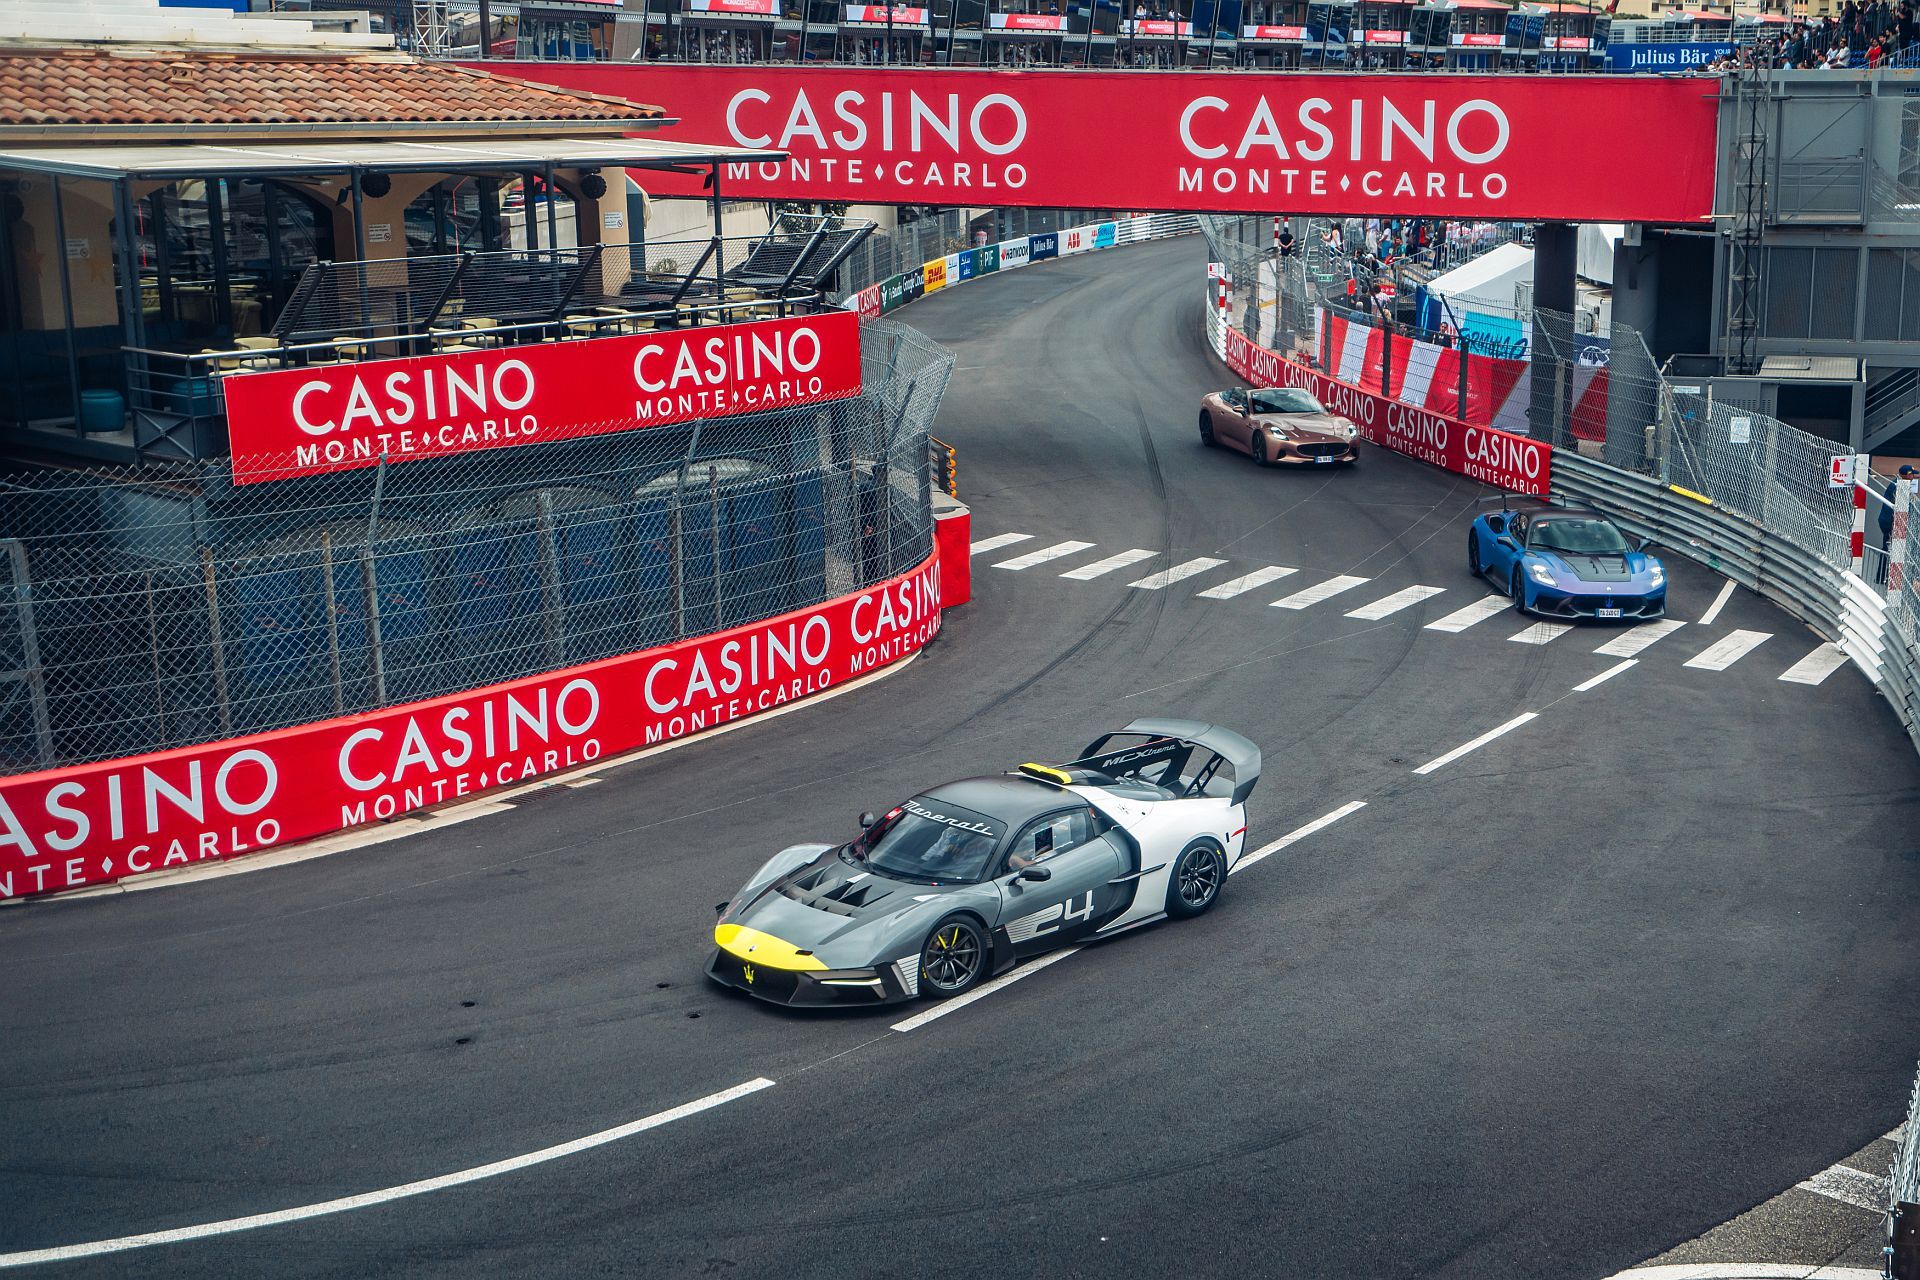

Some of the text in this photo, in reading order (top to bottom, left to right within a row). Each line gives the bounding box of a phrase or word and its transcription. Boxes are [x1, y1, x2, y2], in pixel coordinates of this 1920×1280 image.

[1631, 48, 1710, 68] Julius Bär
[725, 87, 1027, 155] CASINO
[1179, 94, 1510, 164] CASINO
[728, 158, 1027, 188] MONTE CARLO
[1179, 167, 1507, 199] MONTE CARLO
[985, 250, 994, 267] PIF
[1033, 238, 1055, 255] Julius Bär
[1067, 232, 1081, 249] ABB
[903, 275, 915, 293] Google
[926, 266, 944, 284] DHL
[860, 286, 879, 313] CASINO
[633, 328, 821, 392] CASINO
[1228, 329, 1247, 364] CASINO
[1250, 346, 1278, 383] CASINO
[292, 359, 535, 436] CASINO
[635, 376, 822, 420] MONTE CARLO
[1284, 362, 1319, 400] CASINO
[1327, 381, 1375, 425] CASINO
[296, 414, 538, 466] MONTE CARLO
[1387, 403, 1448, 450] CASINO
[1386, 433, 1447, 467] MONTE CARLO
[1464, 427, 1540, 479] CASINO
[1464, 462, 1539, 494] MONTE CARLO
[850, 559, 941, 644] CASINO
[850, 609, 941, 674] MONTE CARL
[644, 615, 831, 714] CASINO
[645, 668, 831, 745] MONTE CARLO
[338, 678, 600, 791] CASINO
[0, 749, 278, 857] ASINO
[342, 738, 601, 828] MONTE CARLO
[901, 800, 994, 836] Maserati
[127, 818, 281, 872] CARLO
[1006, 890, 1094, 942] 24
